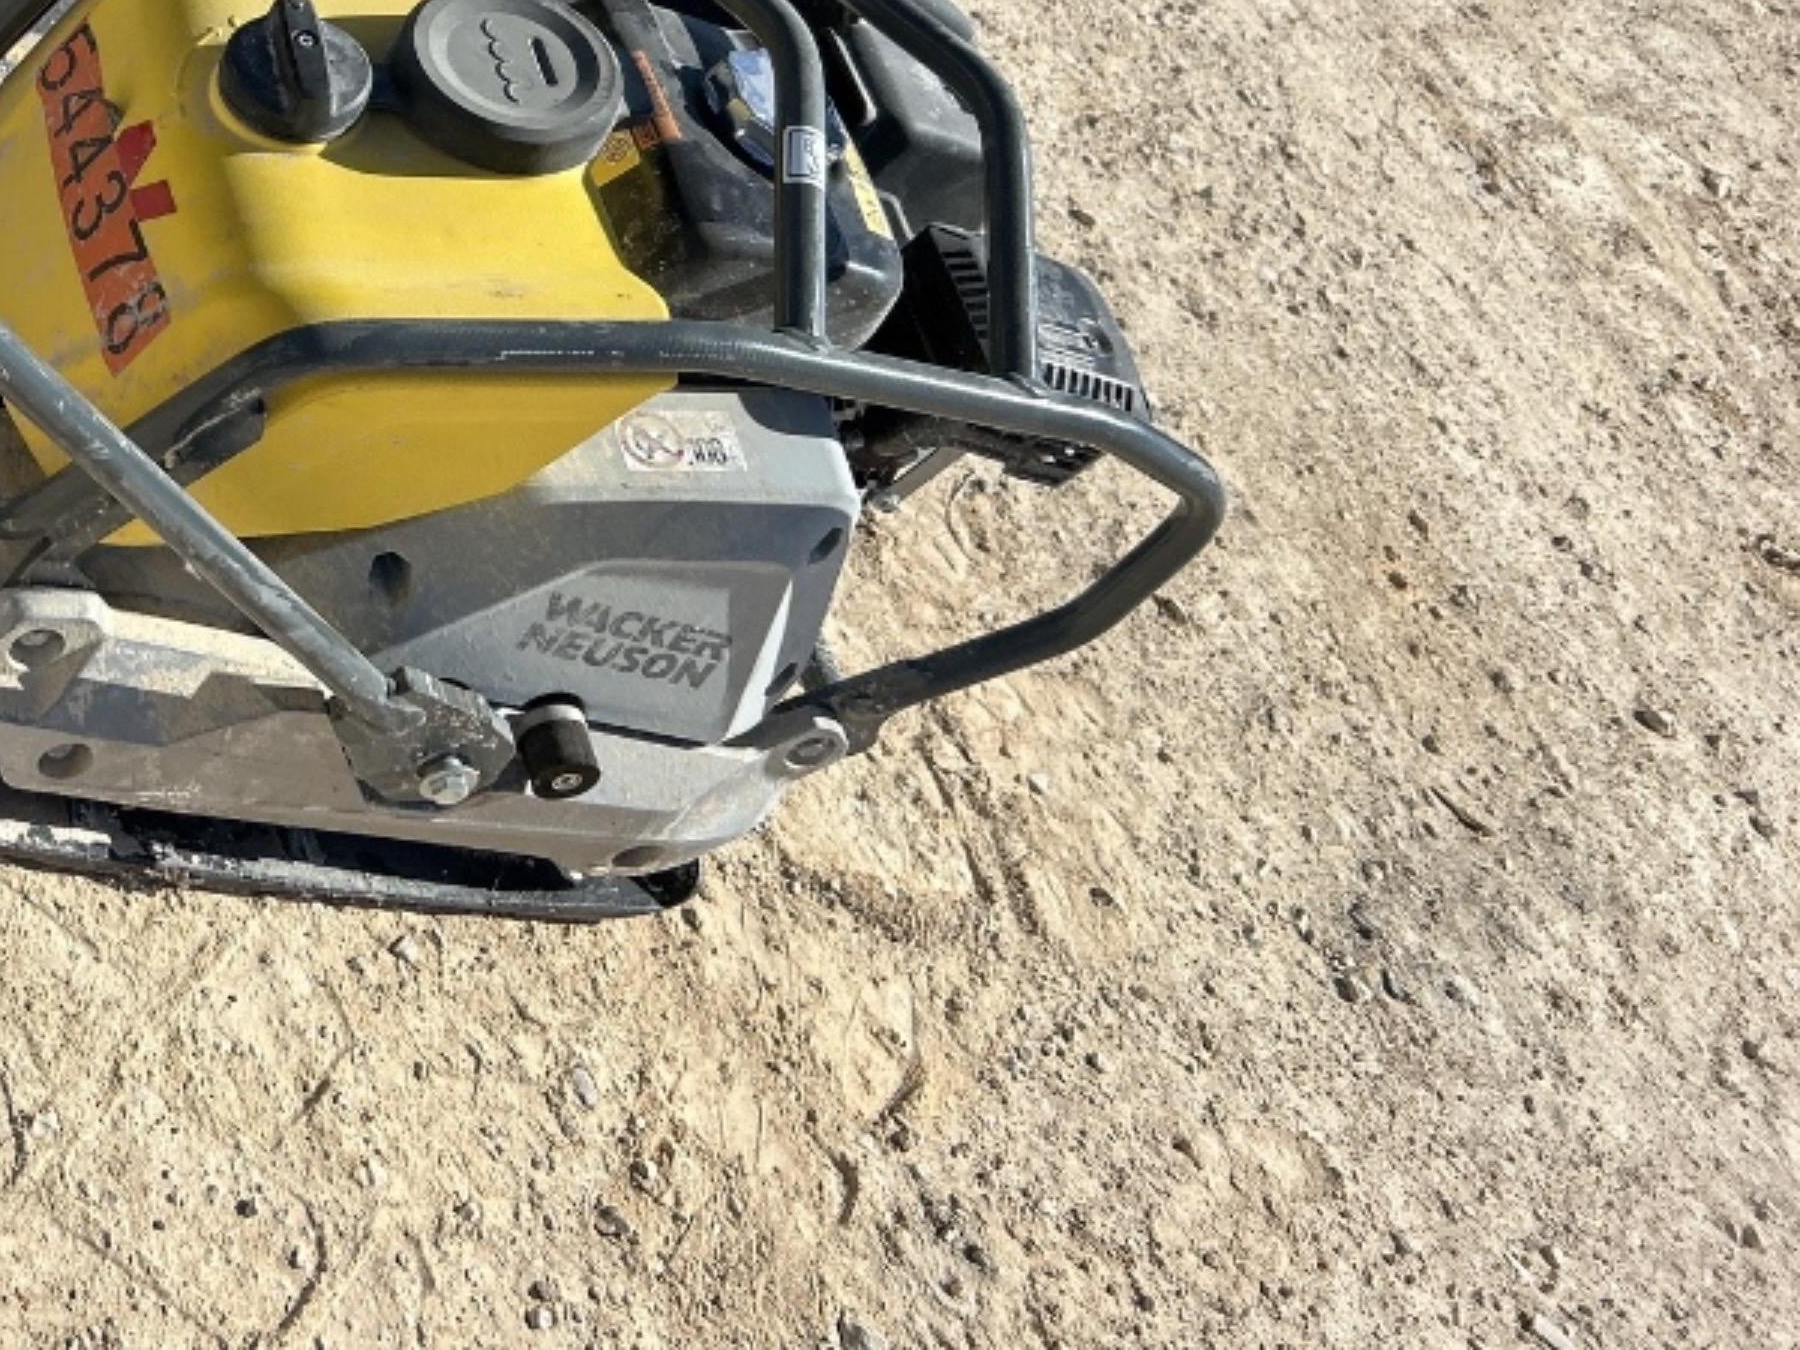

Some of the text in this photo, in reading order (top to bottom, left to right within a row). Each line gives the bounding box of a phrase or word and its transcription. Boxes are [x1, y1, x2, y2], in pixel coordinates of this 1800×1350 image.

[40, 20, 168, 355] 544378
[516, 622, 718, 689] NEUSON
[546, 591, 733, 662] WACKER
